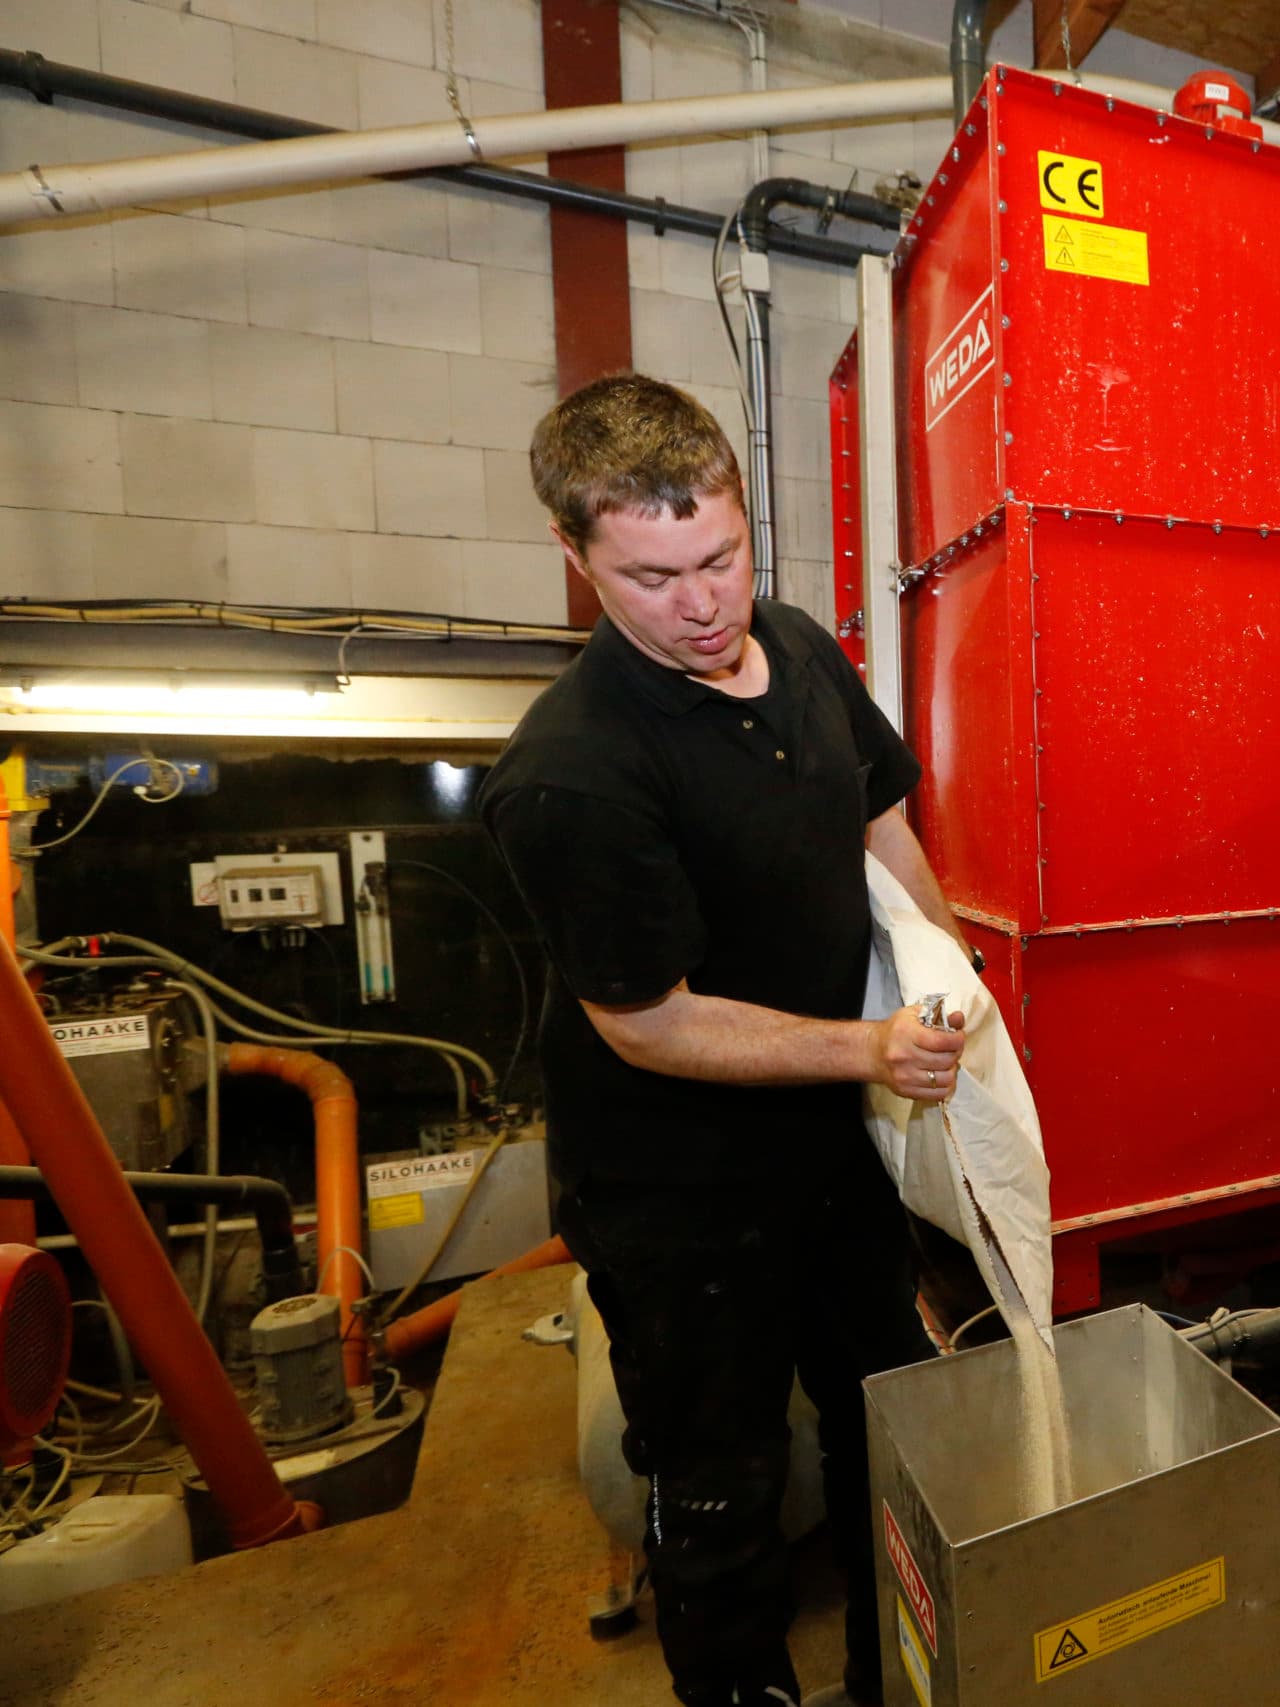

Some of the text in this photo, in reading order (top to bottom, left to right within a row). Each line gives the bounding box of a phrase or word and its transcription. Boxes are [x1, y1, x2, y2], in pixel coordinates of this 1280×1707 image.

[1043, 161, 1100, 211] CE
[929, 317, 992, 407] WEDA
[53, 1020, 146, 1041] OHAAKE
[369, 1156, 473, 1183] SILOHAAKE
[887, 1519, 934, 1637] WEDA
